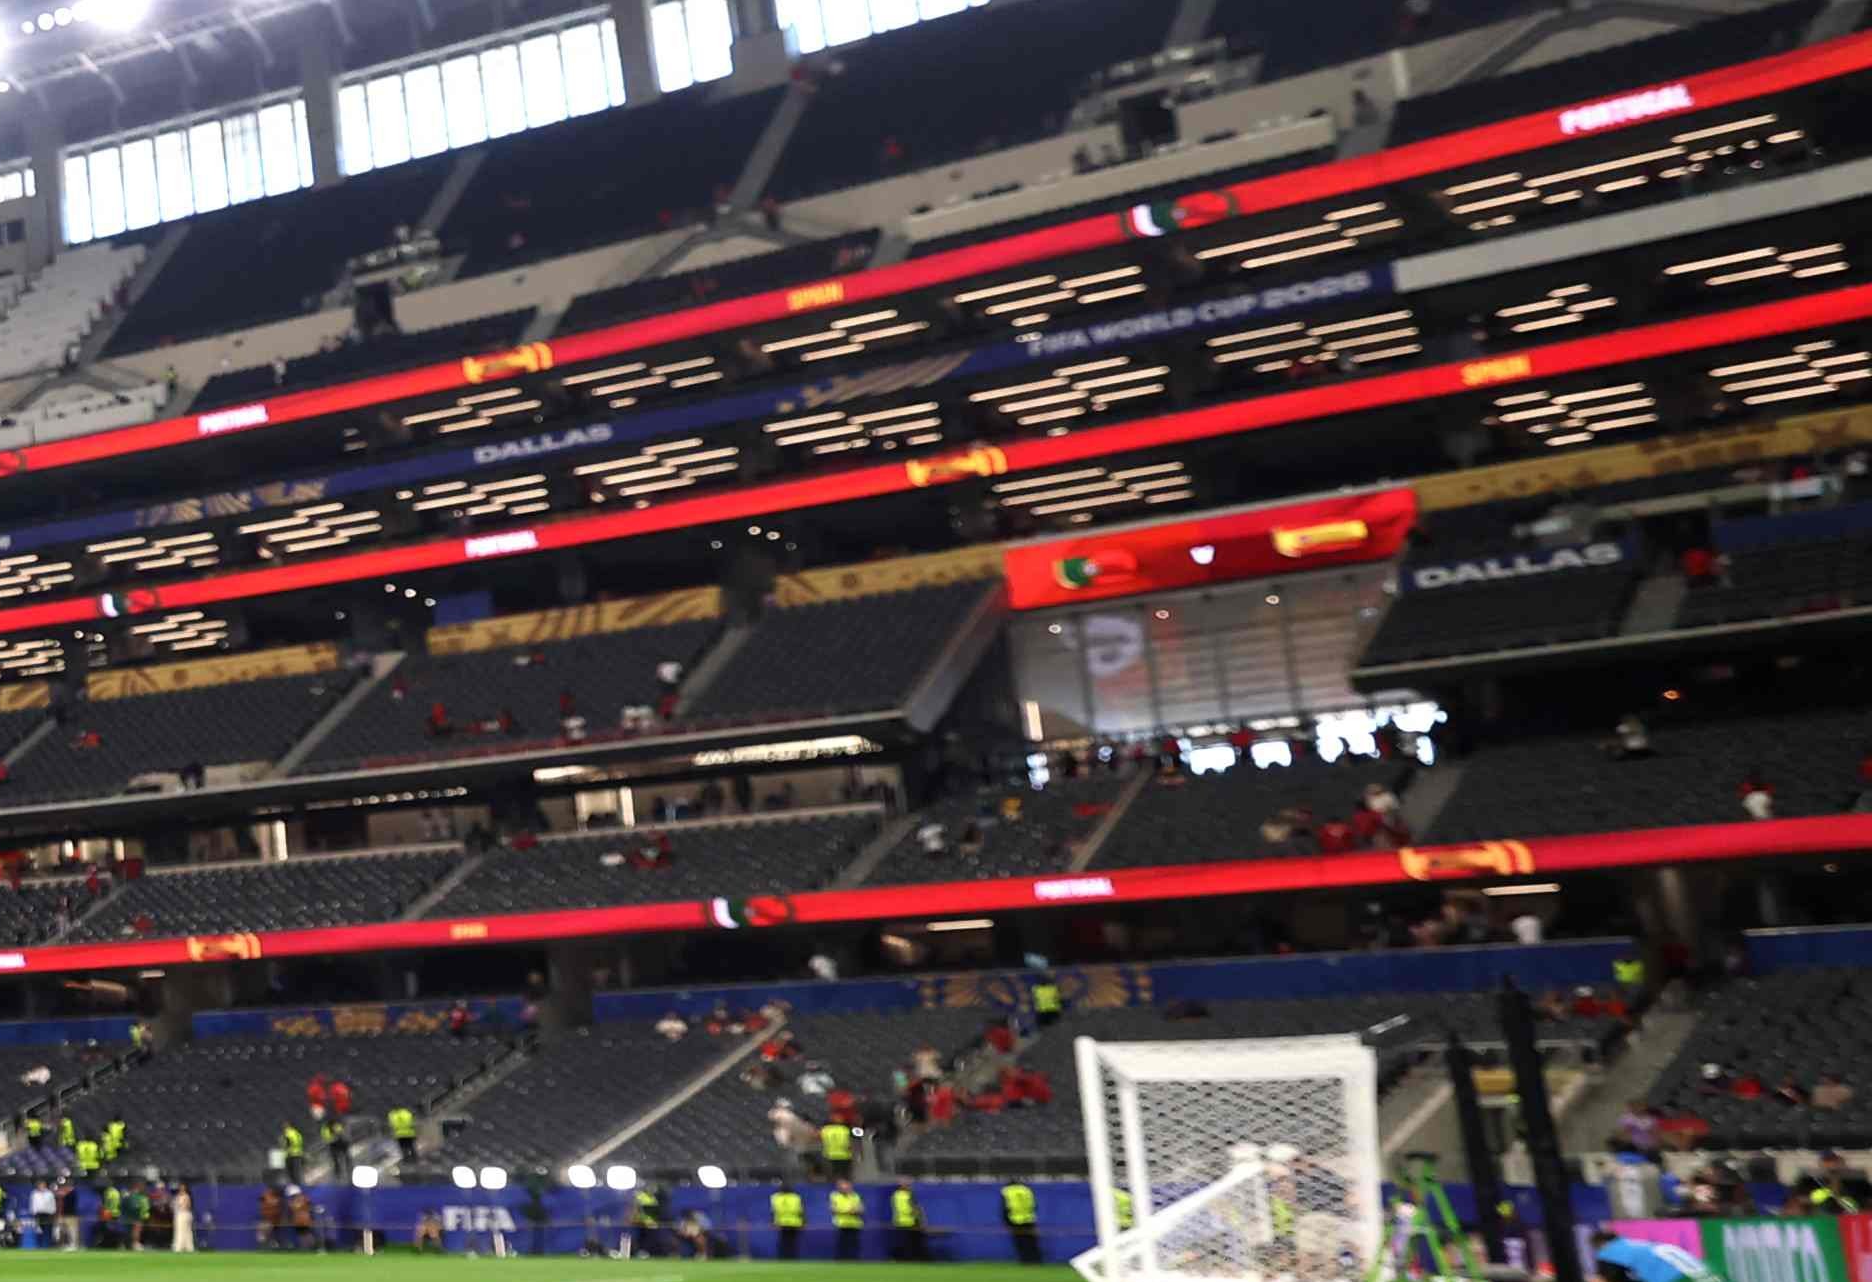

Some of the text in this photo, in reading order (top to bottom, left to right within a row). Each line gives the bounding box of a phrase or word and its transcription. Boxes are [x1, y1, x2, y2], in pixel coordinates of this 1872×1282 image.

[1027, 270, 1372, 357] FIFA WORLD CUP 2026
[473, 423, 614, 464] DALLAS
[1415, 543, 1622, 589] DALLAS
[443, 1205, 516, 1232] FIFA
